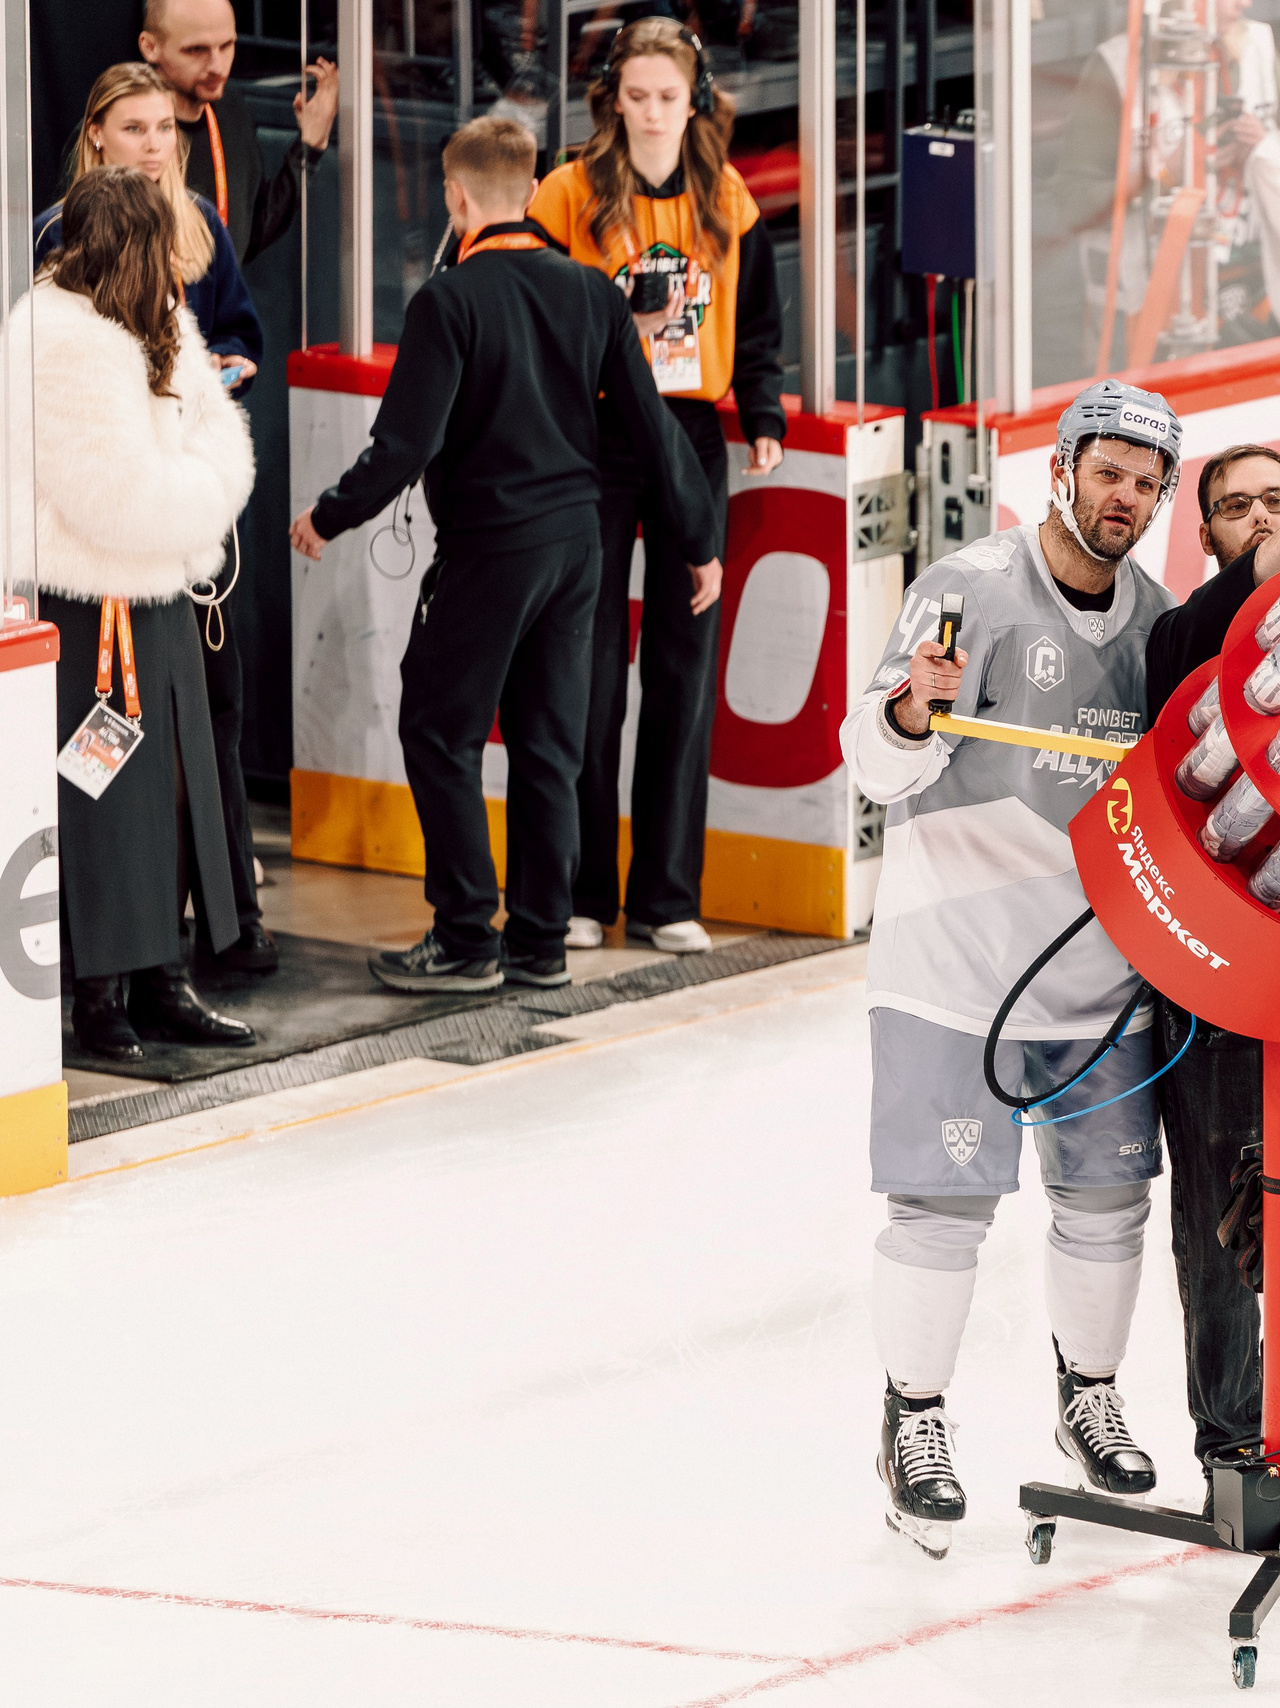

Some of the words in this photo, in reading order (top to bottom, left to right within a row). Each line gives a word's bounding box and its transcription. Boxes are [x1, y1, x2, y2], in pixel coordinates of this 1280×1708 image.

[1123, 411, 1168, 433] согаз
[1077, 707, 1141, 729] FONBET
[1130, 825, 1176, 900] Яндекс
[1116, 842, 1231, 970] Маркет
